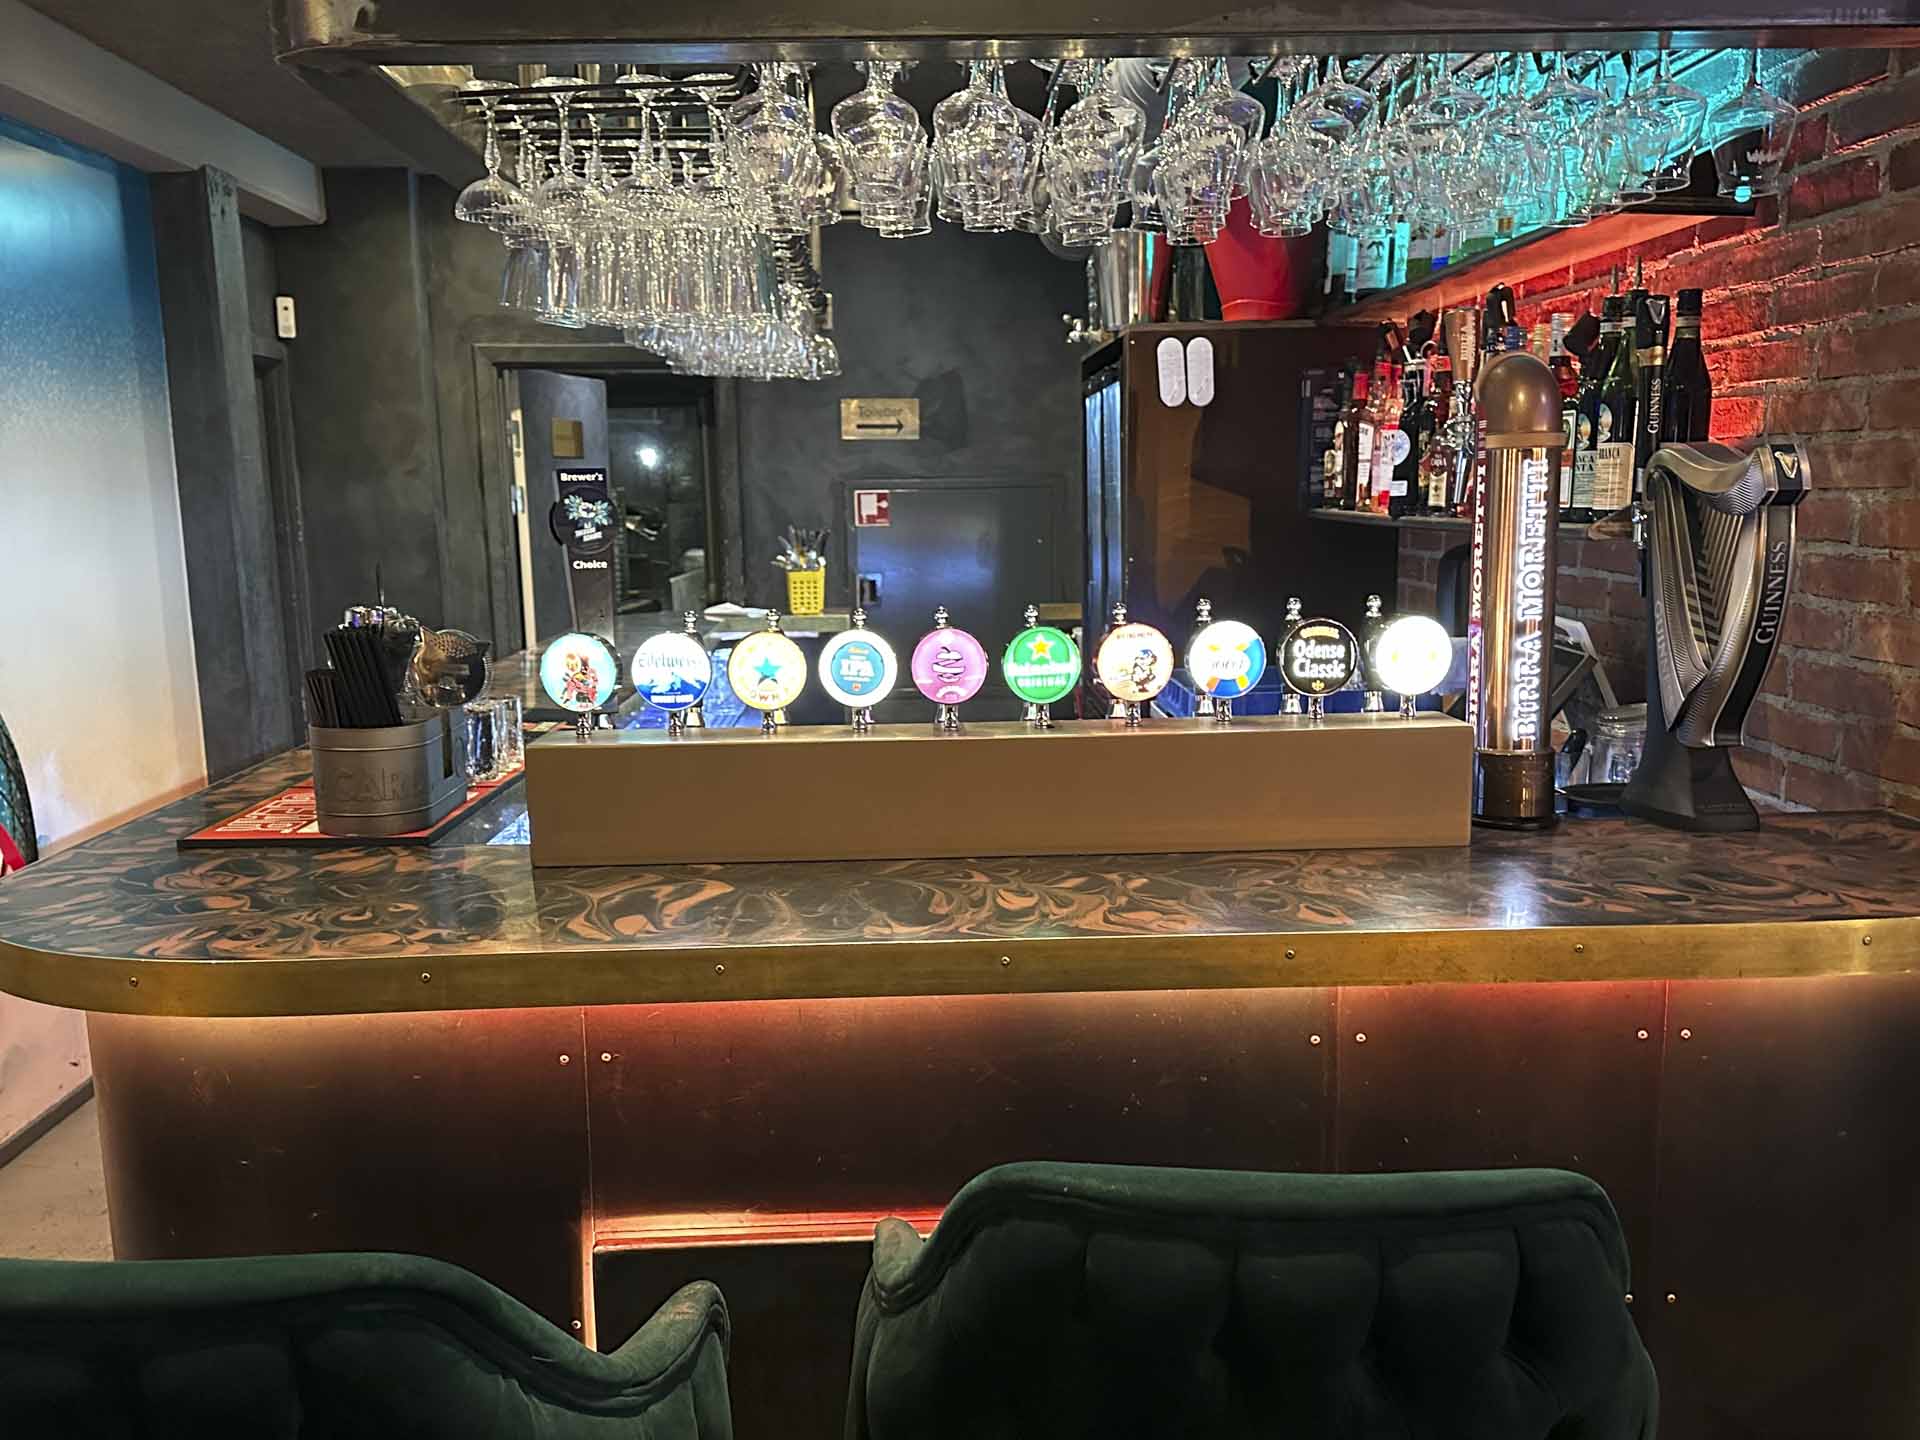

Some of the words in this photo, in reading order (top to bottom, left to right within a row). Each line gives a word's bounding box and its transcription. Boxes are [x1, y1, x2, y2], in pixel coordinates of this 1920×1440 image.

[1647, 378, 1662, 434] GUINNESS
[560, 472, 604, 482] Brewer's
[572, 560, 608, 570] Choice
[1471, 464, 1487, 620] MORETTI
[1517, 458, 1549, 623] MORETTI
[1755, 541, 1787, 644] GUINNESS
[1292, 639, 1345, 659] Odense
[1293, 658, 1346, 678] Classic
[1513, 630, 1542, 741] BIRRA
